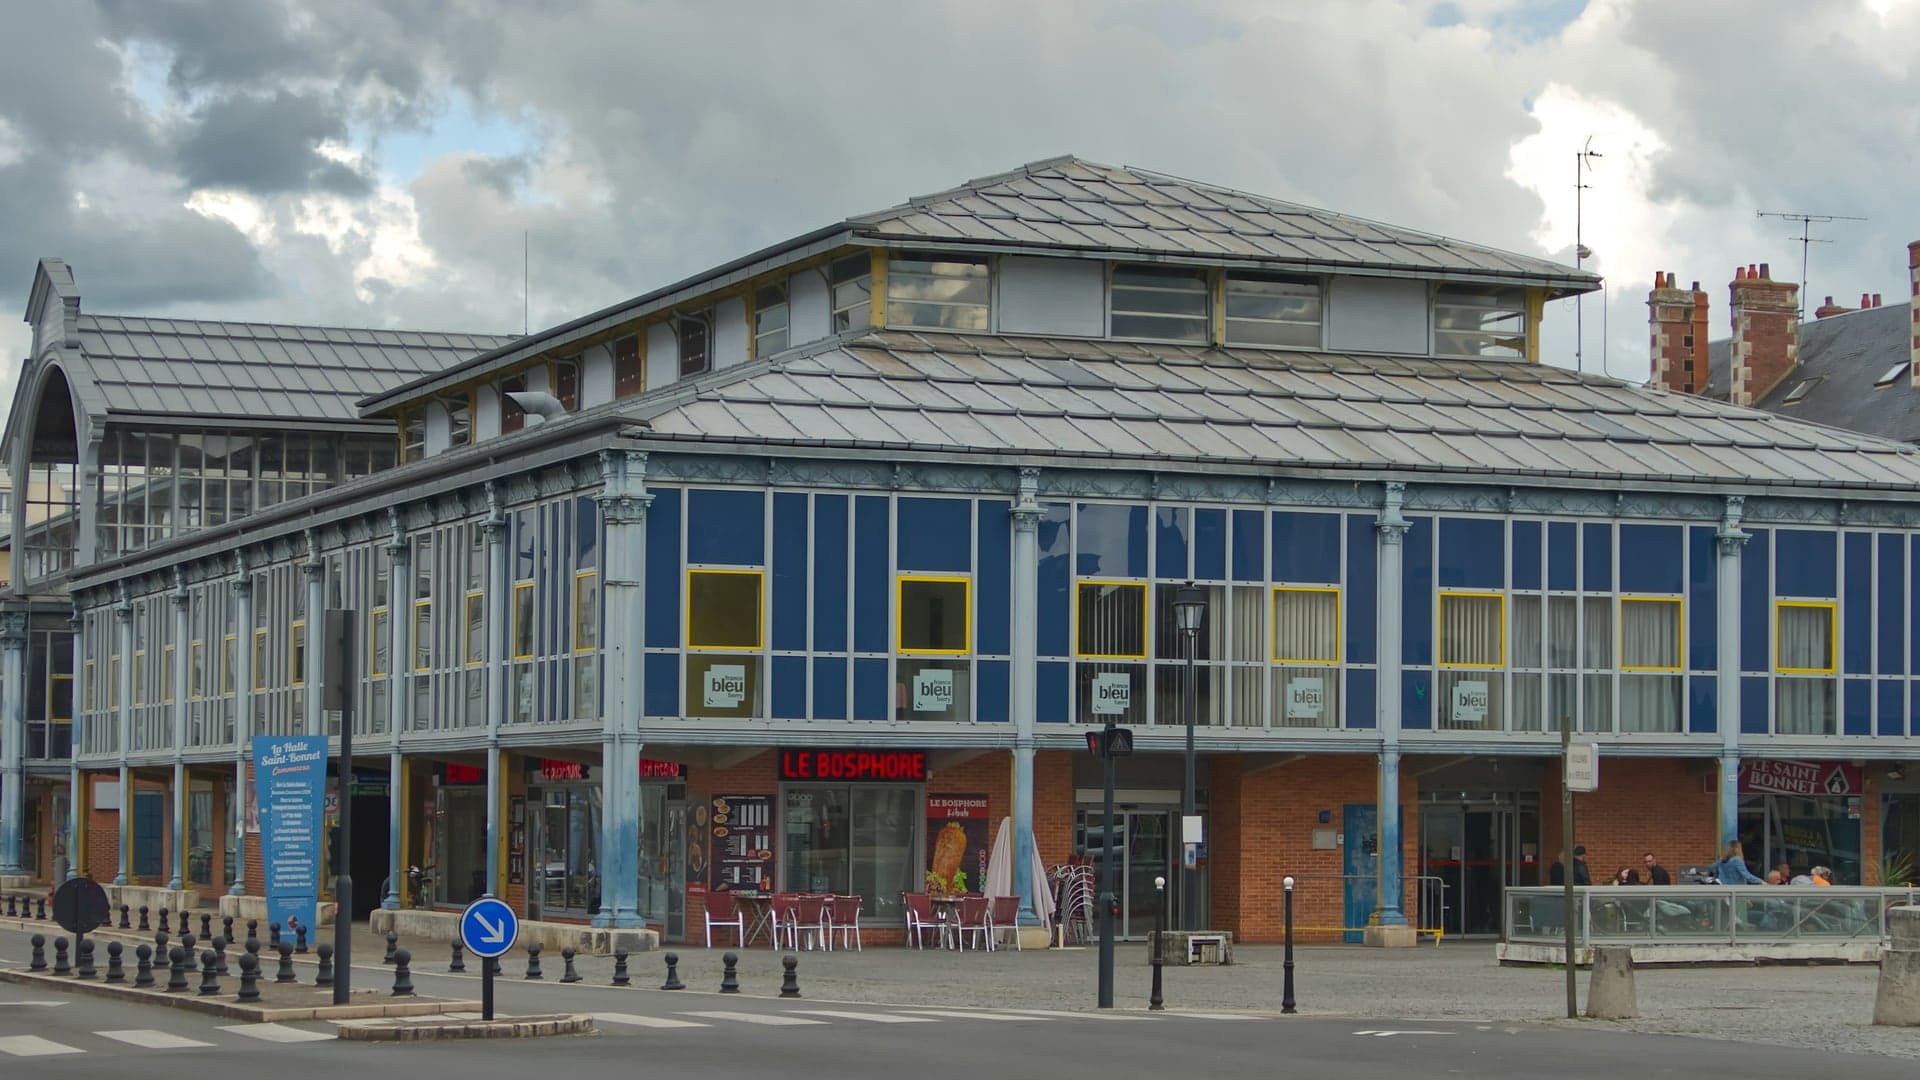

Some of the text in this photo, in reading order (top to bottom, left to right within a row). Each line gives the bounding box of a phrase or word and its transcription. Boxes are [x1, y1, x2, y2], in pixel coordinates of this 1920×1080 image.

[712, 677, 743, 692] bleu
[921, 682, 951, 696] bleu
[1099, 685, 1128, 699] bleu
[1294, 690, 1321, 703] bleu
[1459, 693, 1486, 706] bleu
[271, 741, 308, 756] La Halle
[261, 750, 320, 766] Saint-Bonnet
[784, 752, 925, 778] LE BOSPHORE
[1752, 759, 1819, 782] LE SAINT
[1750, 771, 1819, 794] BONNET
[930, 799, 987, 807] LE BOSPHORE
